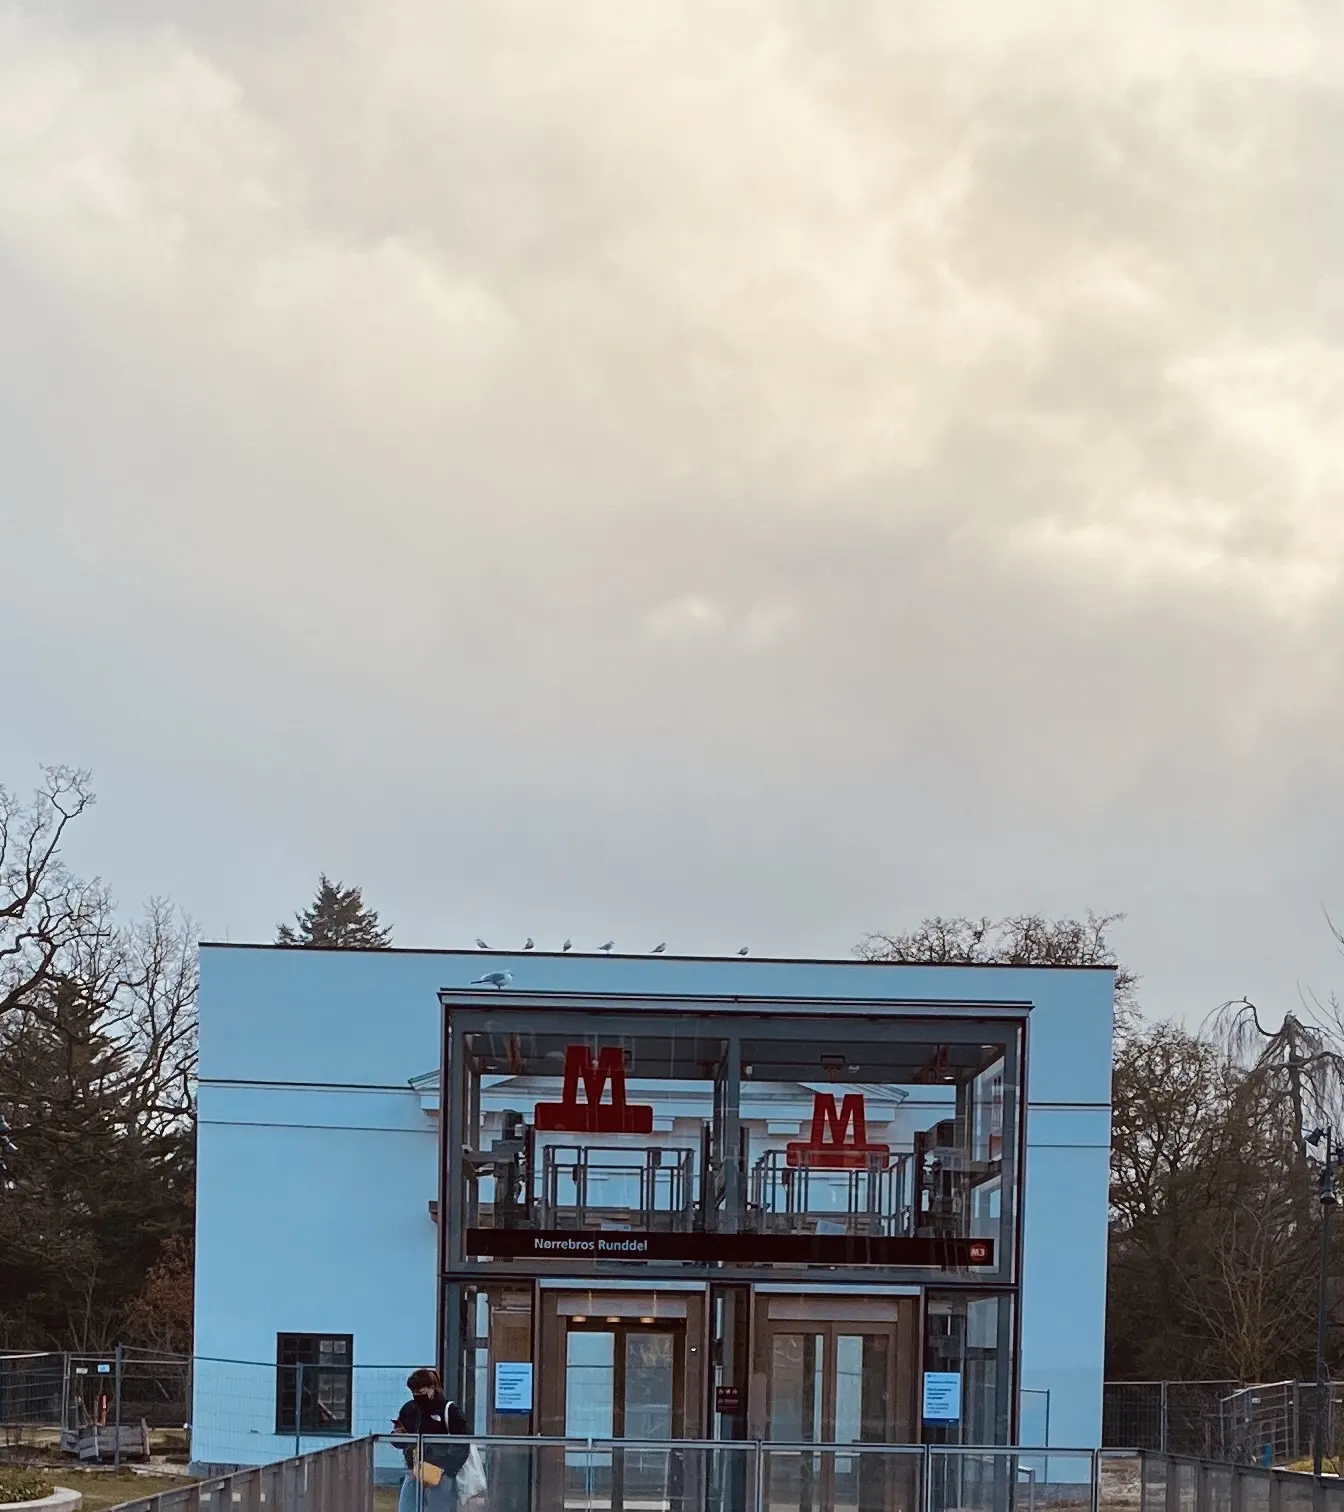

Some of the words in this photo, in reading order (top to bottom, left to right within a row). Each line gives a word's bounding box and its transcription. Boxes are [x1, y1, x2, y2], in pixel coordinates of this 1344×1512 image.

[534, 1238, 595, 1250] Nørrebros
[598, 1239, 648, 1251] Runddel
[970, 1247, 986, 1257] M3
